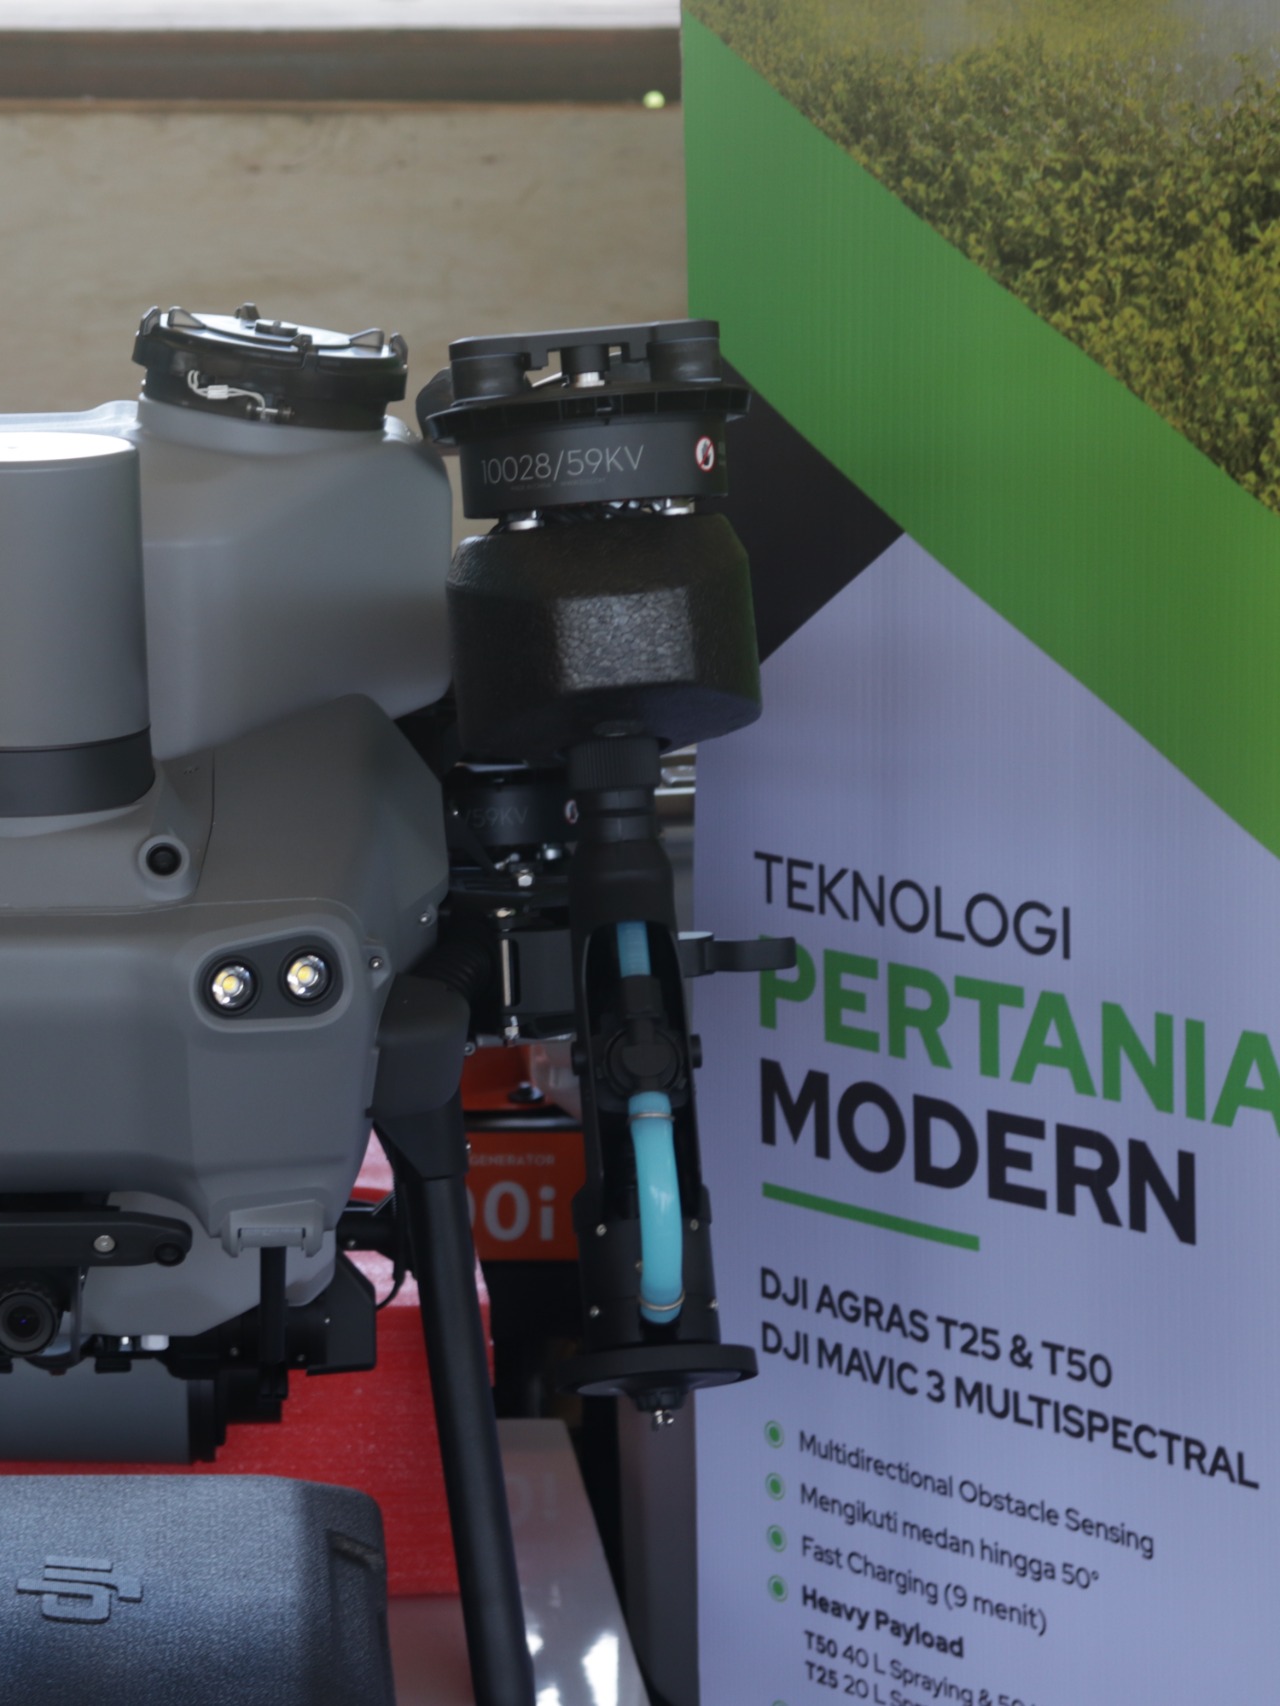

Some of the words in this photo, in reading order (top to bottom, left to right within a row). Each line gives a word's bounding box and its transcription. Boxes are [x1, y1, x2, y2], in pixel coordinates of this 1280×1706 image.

[481, 445, 644, 485] 10028/59KV
[754, 851, 1071, 961] TEKNOLOGI
[759, 934, 1280, 1140] PERTANIA
[469, 1153, 556, 1167] GENERATOR
[760, 1057, 1196, 1247] MODERN
[467, 1180, 556, 1242] 0i
[761, 1266, 808, 1310] DJI
[815, 1284, 929, 1343] AGRAS
[936, 1315, 1001, 1361] T25
[1009, 1334, 1033, 1370] &
[1041, 1341, 1113, 1389] T50
[762, 1321, 809, 1365] DJI
[818, 1337, 918, 1396] MAVIC
[926, 1369, 945, 1404] 3
[955, 1376, 1260, 1491] MULTISPECTRAL
[799, 1430, 953, 1498] Multidirectional
[958, 1479, 1060, 1527] Obstacle
[1065, 1507, 1155, 1560] Sensing
[801, 1483, 898, 1534] Mengikuti
[902, 1520, 974, 1558] medan
[980, 1538, 1056, 1582] hingga
[802, 1535, 843, 1570] Fast
[847, 1550, 939, 1606] Charging
[944, 1582, 968, 1611] (9
[973, 1594, 1047, 1637] menit)
[802, 1585, 870, 1631] Heavy
[875, 1609, 964, 1658] Payload
[804, 1630, 837, 1659] T50
[842, 1645, 869, 1669] 40
[874, 1653, 886, 1675] L
[889, 1658, 972, 1706] Spraying
[804, 1660, 838, 1689] T25
[844, 1675, 869, 1699] 20
[874, 1684, 886, 1706] L
